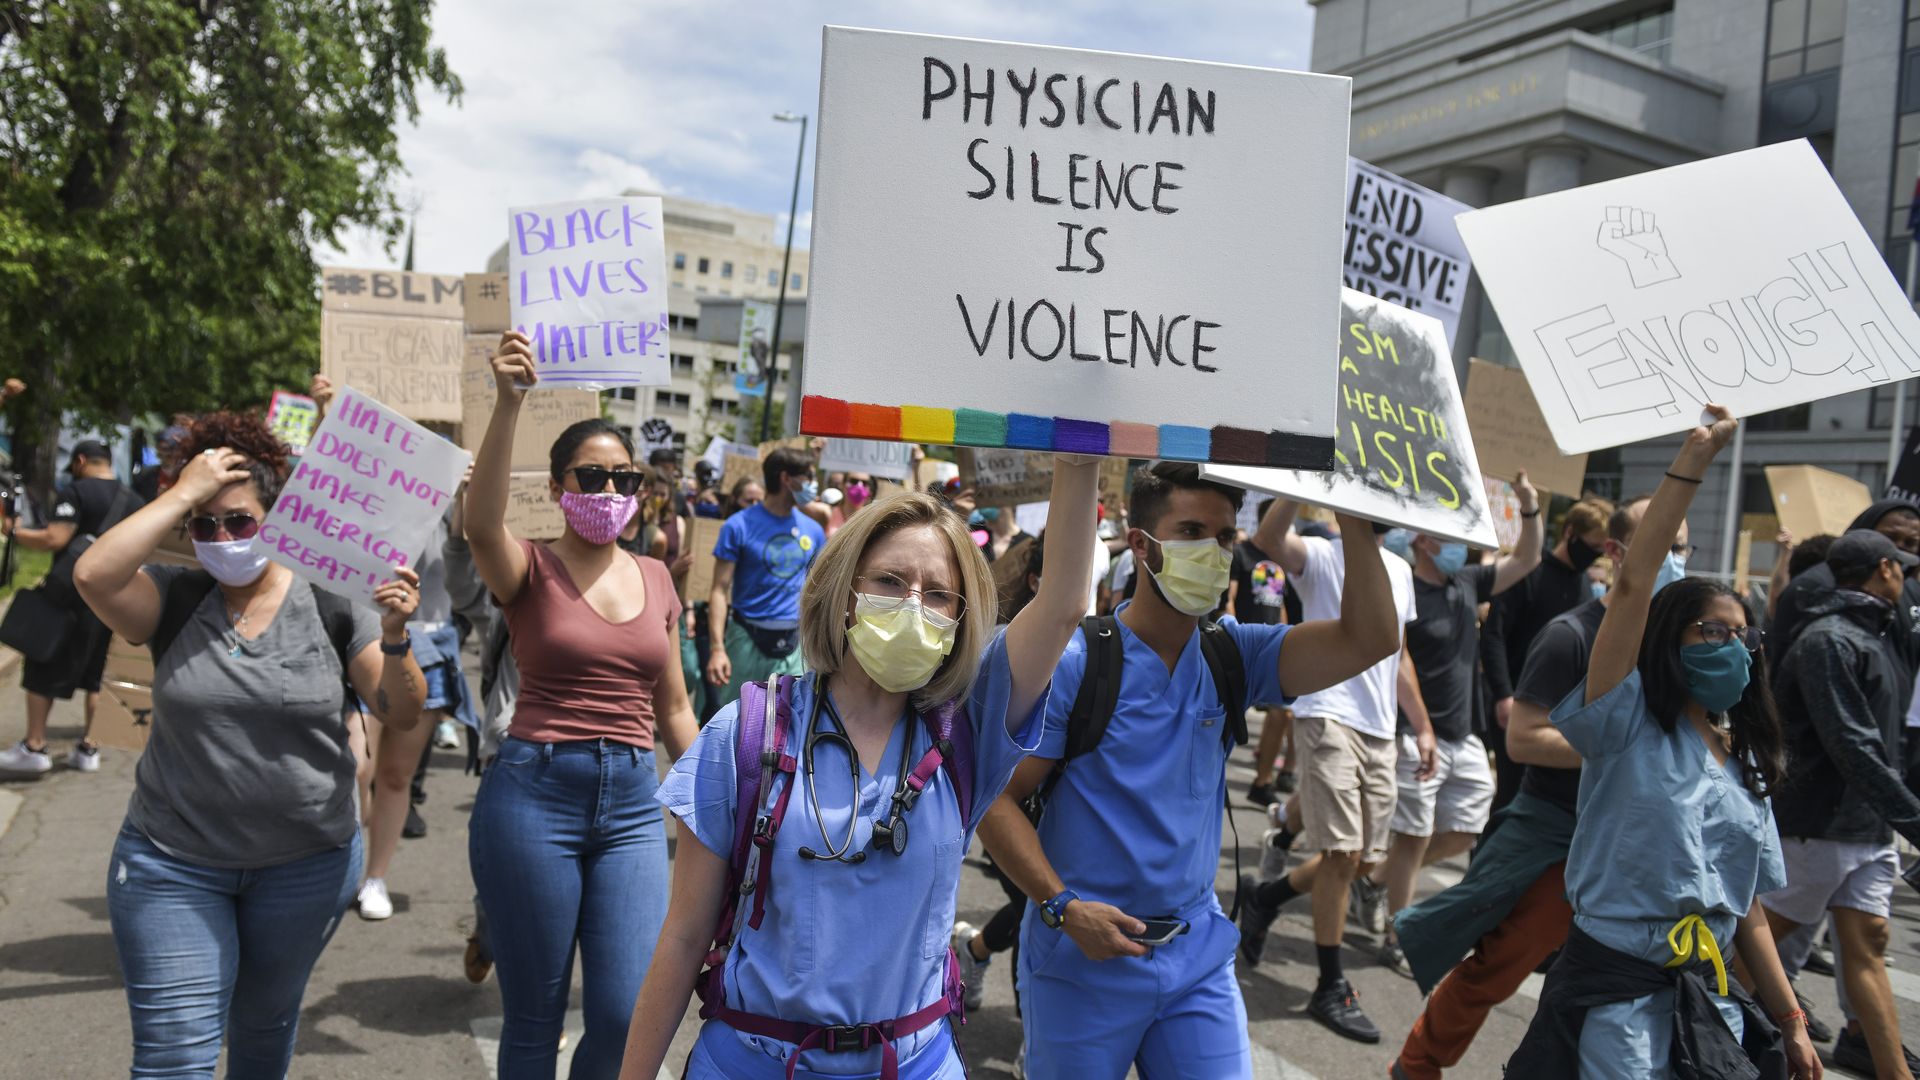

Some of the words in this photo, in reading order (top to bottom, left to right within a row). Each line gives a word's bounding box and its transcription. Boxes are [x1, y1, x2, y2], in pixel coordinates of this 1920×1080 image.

[921, 56, 1216, 136] PHYSICIAN
[967, 138, 1186, 214] SILENCE
[1349, 173, 1424, 237] END
[514, 204, 653, 256] BLACK
[1056, 221, 1108, 273] IS
[326, 272, 464, 306] #BLM
[520, 258, 649, 307] LIVES
[1344, 222, 1459, 304] ESSIVE
[337, 323, 380, 362] I
[956, 293, 1222, 373] VIOLENCE
[1340, 323, 1400, 365] SM
[1534, 241, 1920, 423] ENOUGH
[1341, 355, 1360, 376] A
[338, 394, 424, 455] HATE
[1343, 383, 1448, 441] HEALTH
[295, 462, 385, 515] MAKE
[316, 431, 387, 479] DOES
[388, 469, 450, 507] NOT
[258, 523, 361, 581] GREAT
[276, 493, 409, 567] AMERICA
